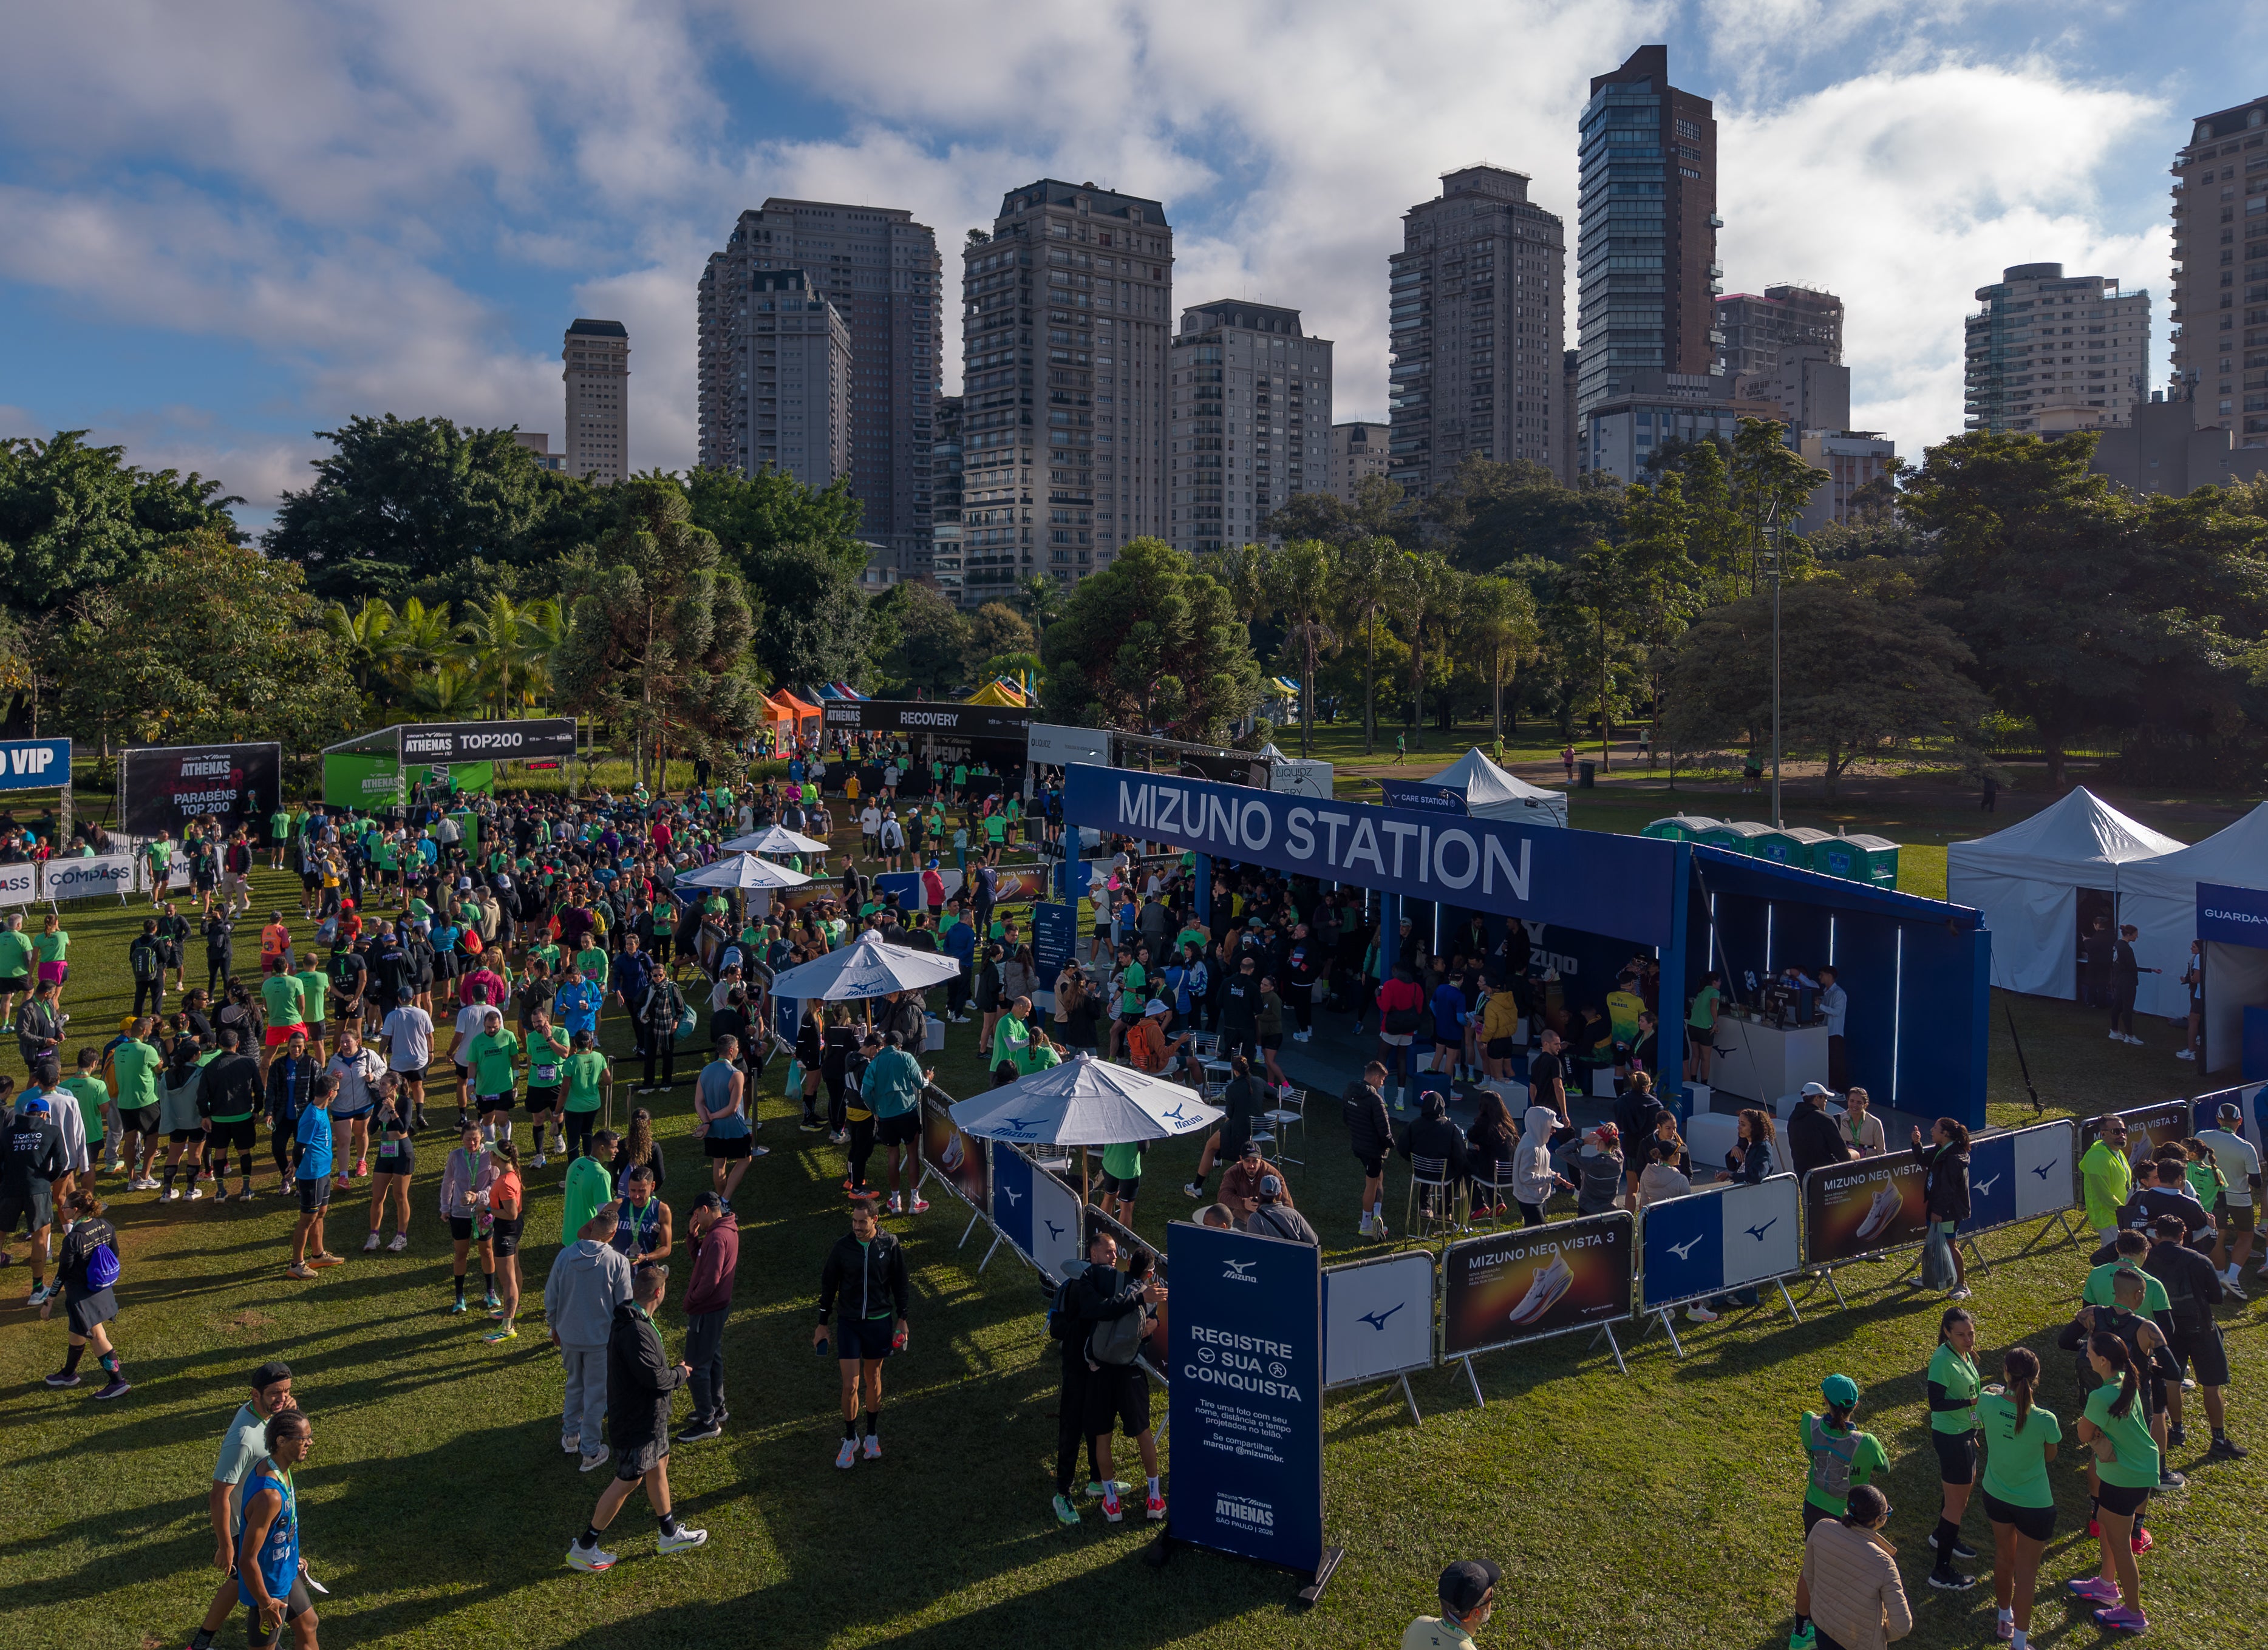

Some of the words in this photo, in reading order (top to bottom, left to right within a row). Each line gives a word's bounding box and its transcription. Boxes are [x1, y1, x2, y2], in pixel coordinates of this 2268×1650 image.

[827, 710, 860, 722] ATHENAS
[901, 711, 959, 727] RECOVERY
[405, 739, 452, 752] ATHENAS
[460, 733, 523, 749] TOP200
[11, 748, 53, 775] VIP
[181, 761, 230, 776] ATHENAS
[1276, 767, 1313, 778] LIQUIDZ
[362, 778, 398, 789] ATHENAS
[174, 788, 237, 804] PARABÉNS
[1401, 794, 1419, 803] CARE
[1420, 796, 1448, 806] STATION
[181, 804, 205, 815] TOP
[207, 801, 230, 813] 200
[1119, 781, 1272, 851] MIZUNO
[1285, 806, 1531, 901] STATION
[50, 867, 129, 886] COMPASS
[927, 1096, 947, 1117] MIZUNO
[2128, 1122, 2145, 1133] NEO
[2147, 1117, 2171, 1129] VISTA
[1824, 1174, 1865, 1191] MIZUNO
[1869, 1169, 1890, 1182] NEO
[1893, 1164, 1923, 1177] VISTA
[1469, 1248, 1525, 1269] MIZUNO
[1530, 1243, 1558, 1257] NEO
[1562, 1234, 1602, 1251] VISTA
[1607, 1232, 1615, 1243] 3
[1191, 1325, 1293, 1359] REGISTRE
[1221, 1352, 1263, 1373] SUA
[1184, 1364, 1302, 1402] CONQUISTA
[1200, 1399, 1215, 1408] Tire
[1217, 1404, 1234, 1413] uma
[1236, 1407, 1251, 1416] foto
[1253, 1412, 1270, 1421] com
[1195, 1407, 1219, 1417] nome,
[1221, 1413, 1256, 1425] distância
[1266, 1422, 1292, 1433] tempo
[1206, 1417, 1247, 1431] projetados
[1261, 1428, 1282, 1439] telão.
[1204, 1439, 1233, 1451] marque
[1236, 1446, 1284, 1463] @mizunobr.
[1213, 1433, 1224, 1441] Se
[1225, 1437, 1274, 1453] compartilhar,
[1217, 1492, 1238, 1501] CIRCUITO
[1216, 1499, 1273, 1526] ATHENAS
[1231, 1521, 1253, 1530] PAULO
